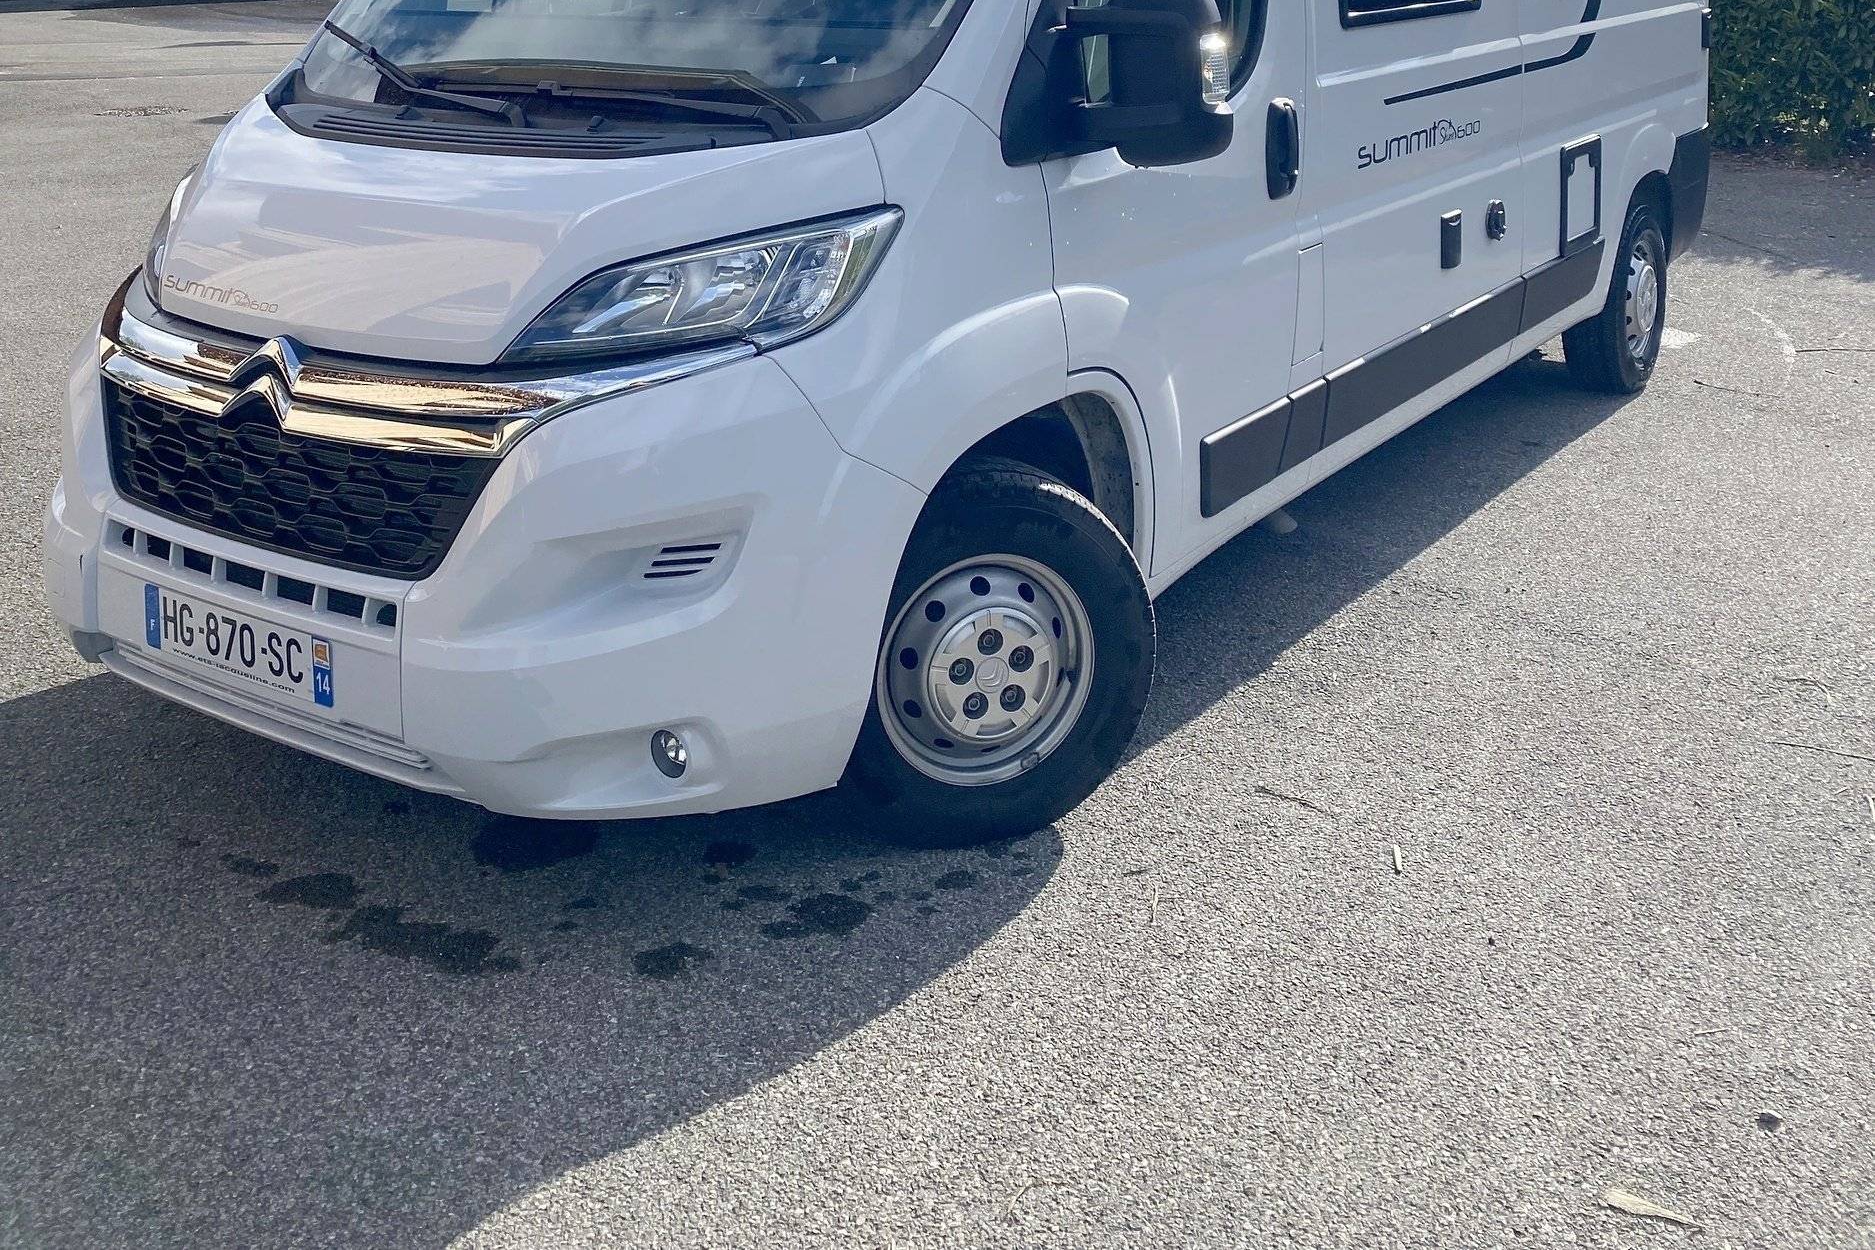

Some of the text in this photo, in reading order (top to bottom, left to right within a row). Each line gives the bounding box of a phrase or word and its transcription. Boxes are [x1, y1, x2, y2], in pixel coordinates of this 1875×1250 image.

[1457, 119, 1481, 139] 600
[250, 300, 279, 314] 600
[150, 618, 156, 631] F
[162, 596, 304, 684] HG-870-SC
[316, 671, 331, 695] 14
